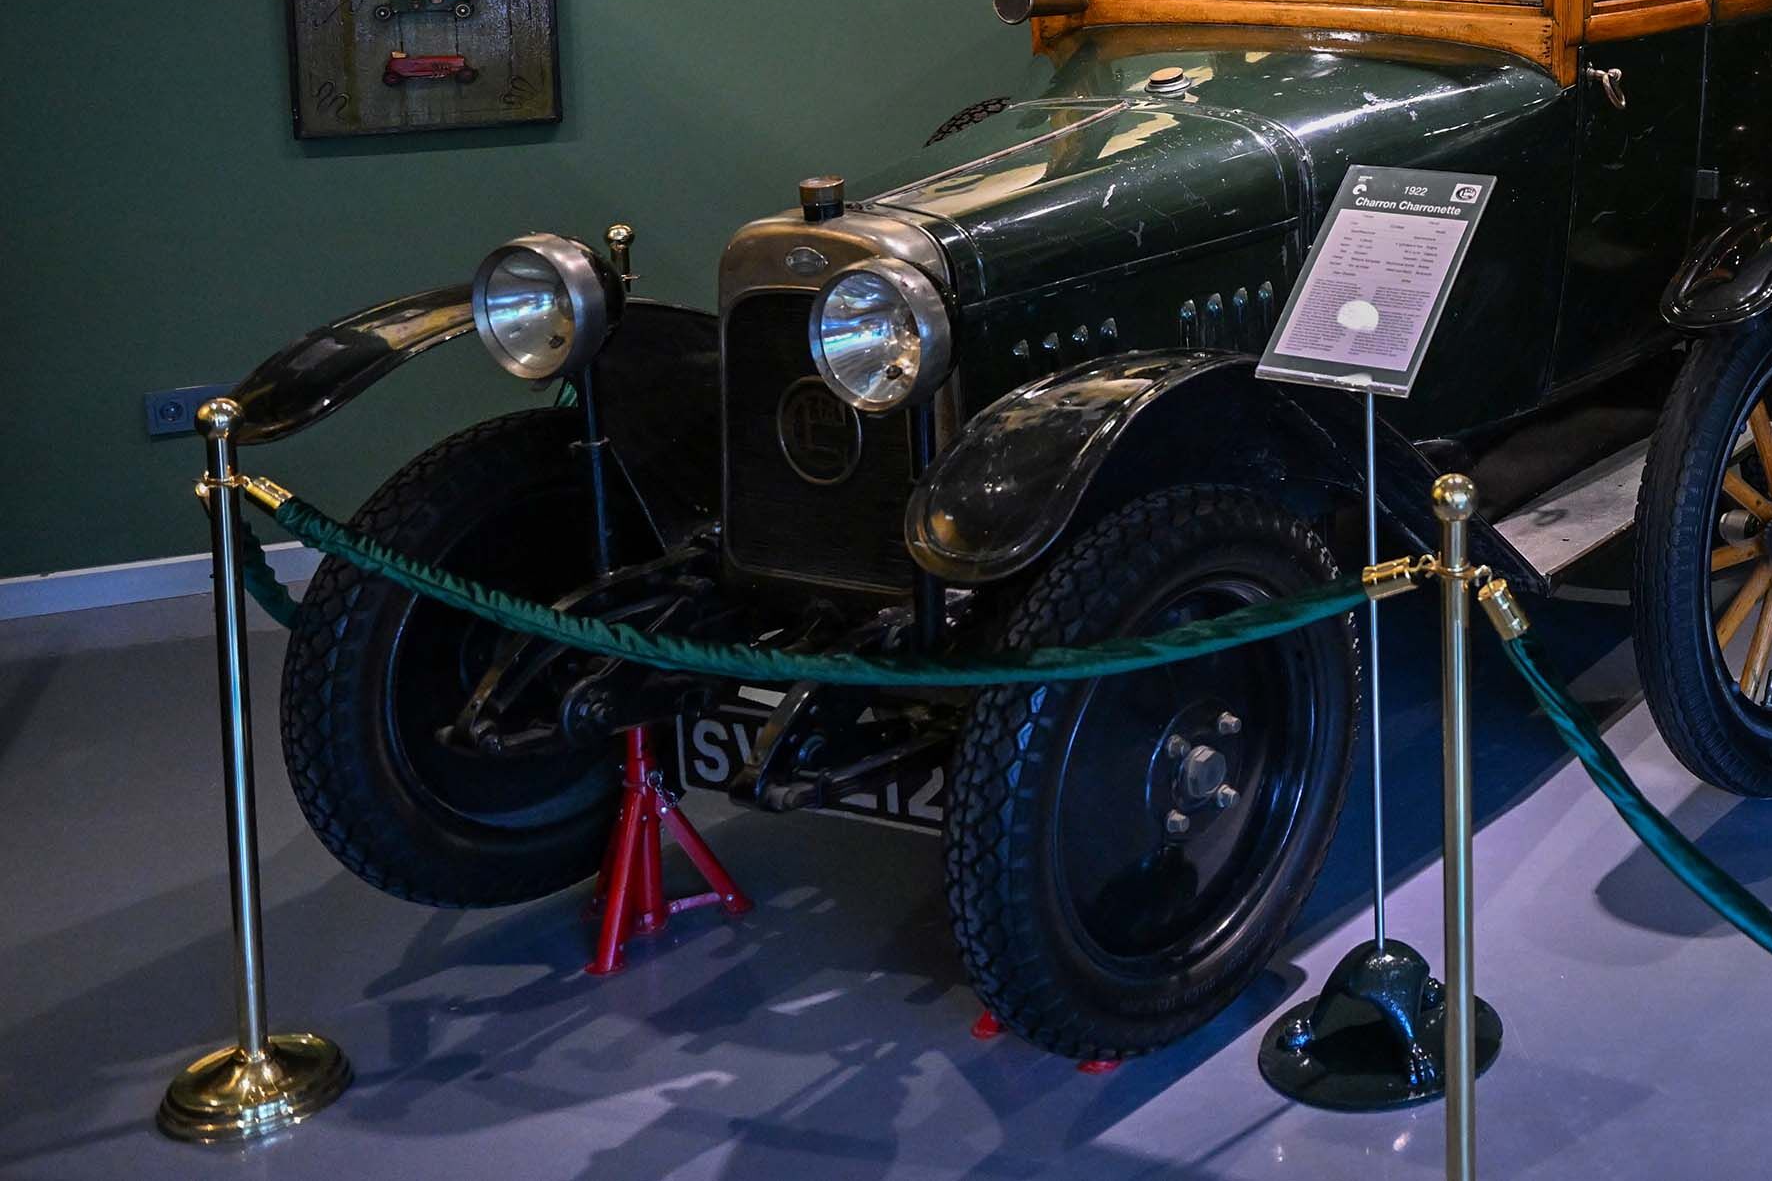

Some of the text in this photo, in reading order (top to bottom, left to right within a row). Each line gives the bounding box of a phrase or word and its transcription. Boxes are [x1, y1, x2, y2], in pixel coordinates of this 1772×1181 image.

[1403, 185, 1429, 197] 1922
[1355, 197, 1462, 216] Charron Charronette
